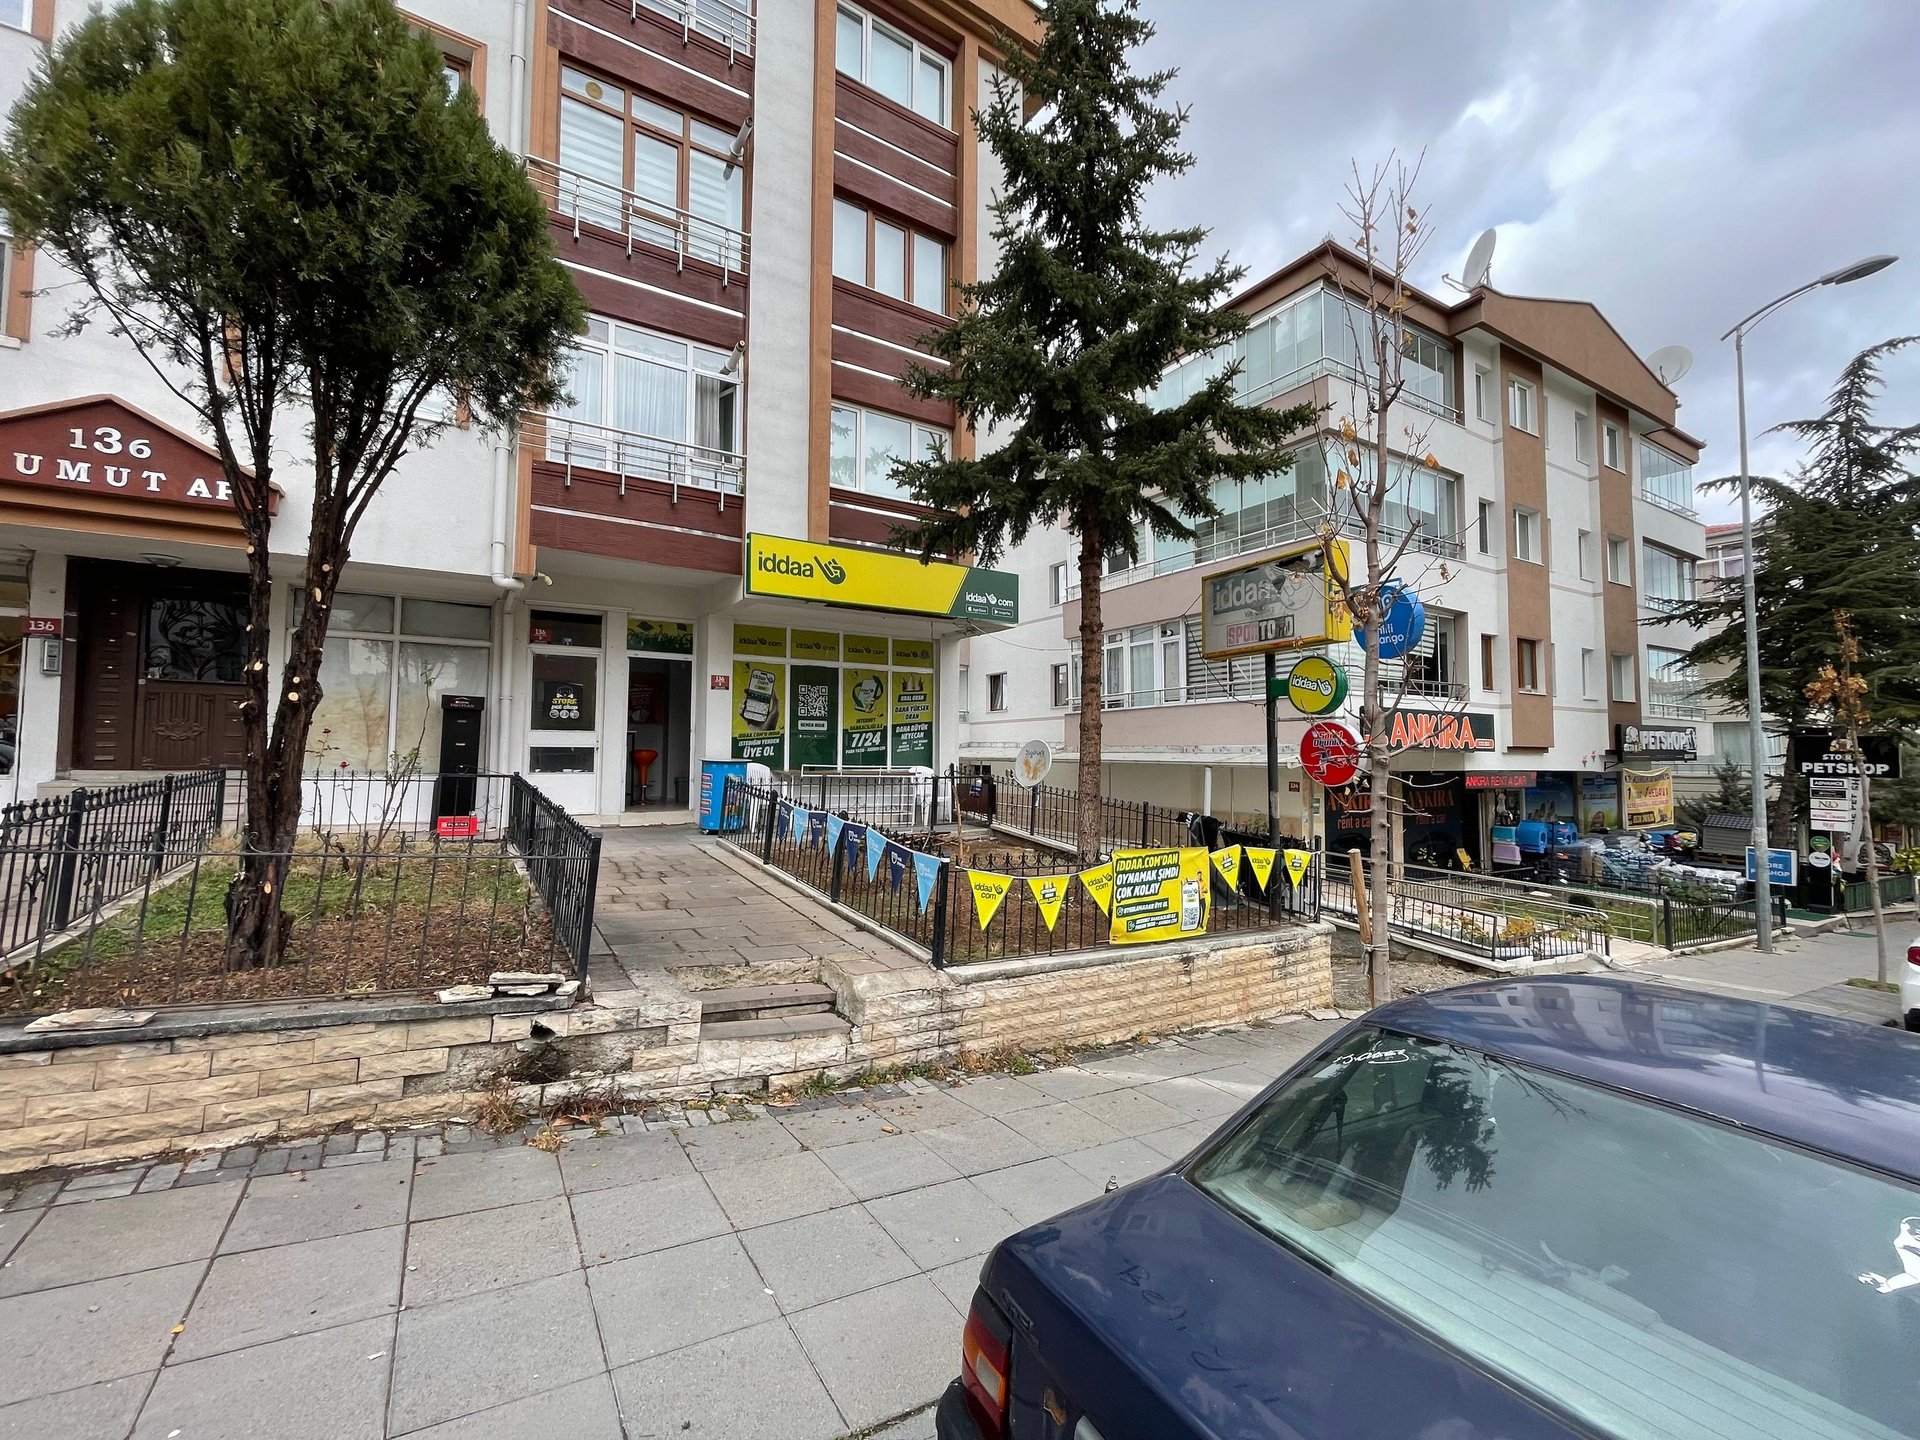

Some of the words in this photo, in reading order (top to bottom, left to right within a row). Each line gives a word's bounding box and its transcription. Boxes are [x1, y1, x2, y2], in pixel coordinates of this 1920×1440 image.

[70, 427, 152, 459] 136
[13, 452, 167, 492] UMUT
[758, 551, 814, 578] iddaa
[966, 592, 987, 603] iddaa
[998, 599, 1014, 607] com
[29, 620, 55, 632] 136
[1291, 675, 1317, 691] iddaa
[851, 732, 881, 748] 7/24
[1640, 730, 1686, 750] PETSHOP
[743, 745, 762, 758] ÜYE
[763, 746, 775, 757] OL
[1801, 762, 1890, 775] PETSHOP
[1327, 793, 1371, 811] ANKIR
[1407, 789, 1455, 808] ANKIRA
[1337, 817, 1354, 830] rent
[1117, 870, 1157, 885] OYNAMAK
[1750, 868, 1790, 877] PHOP
[974, 882, 992, 893] iddaa
[1087, 877, 1104, 887] iddaa
[1096, 883, 1108, 891] com
[981, 891, 996, 900] com
[1117, 885, 1133, 901] ÇOK
[1133, 882, 1160, 896] KOLAY
